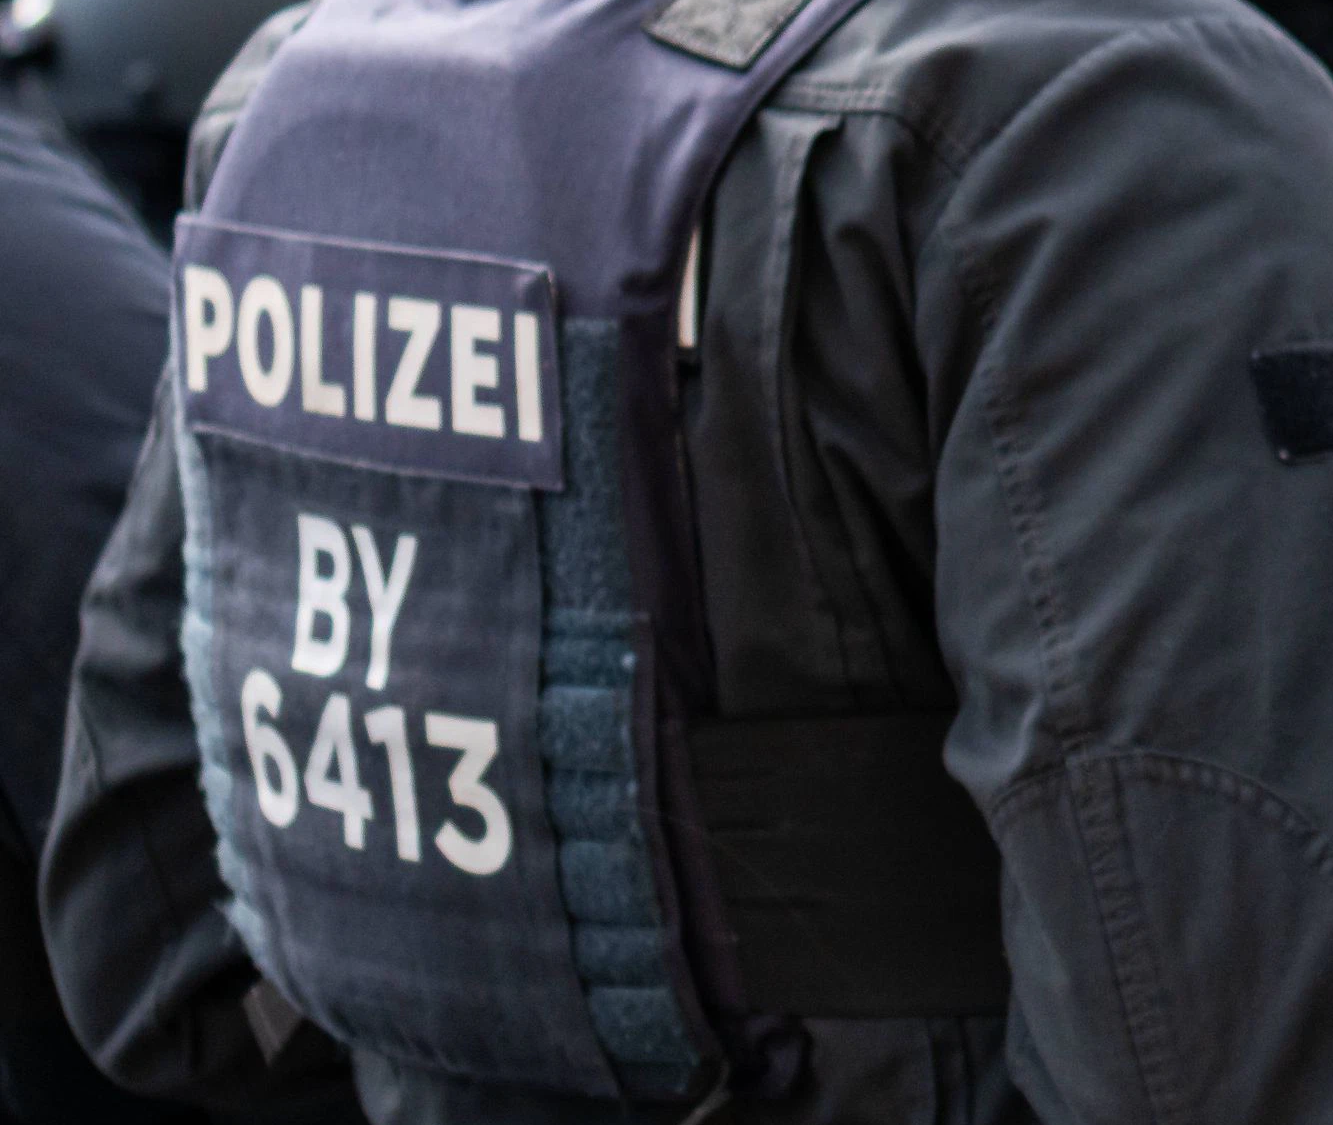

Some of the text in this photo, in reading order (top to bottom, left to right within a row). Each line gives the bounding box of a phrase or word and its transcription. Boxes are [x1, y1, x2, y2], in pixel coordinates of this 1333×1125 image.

[183, 264, 544, 443] POLIZEI
[290, 513, 418, 692] BY
[239, 665, 513, 876] 6413
